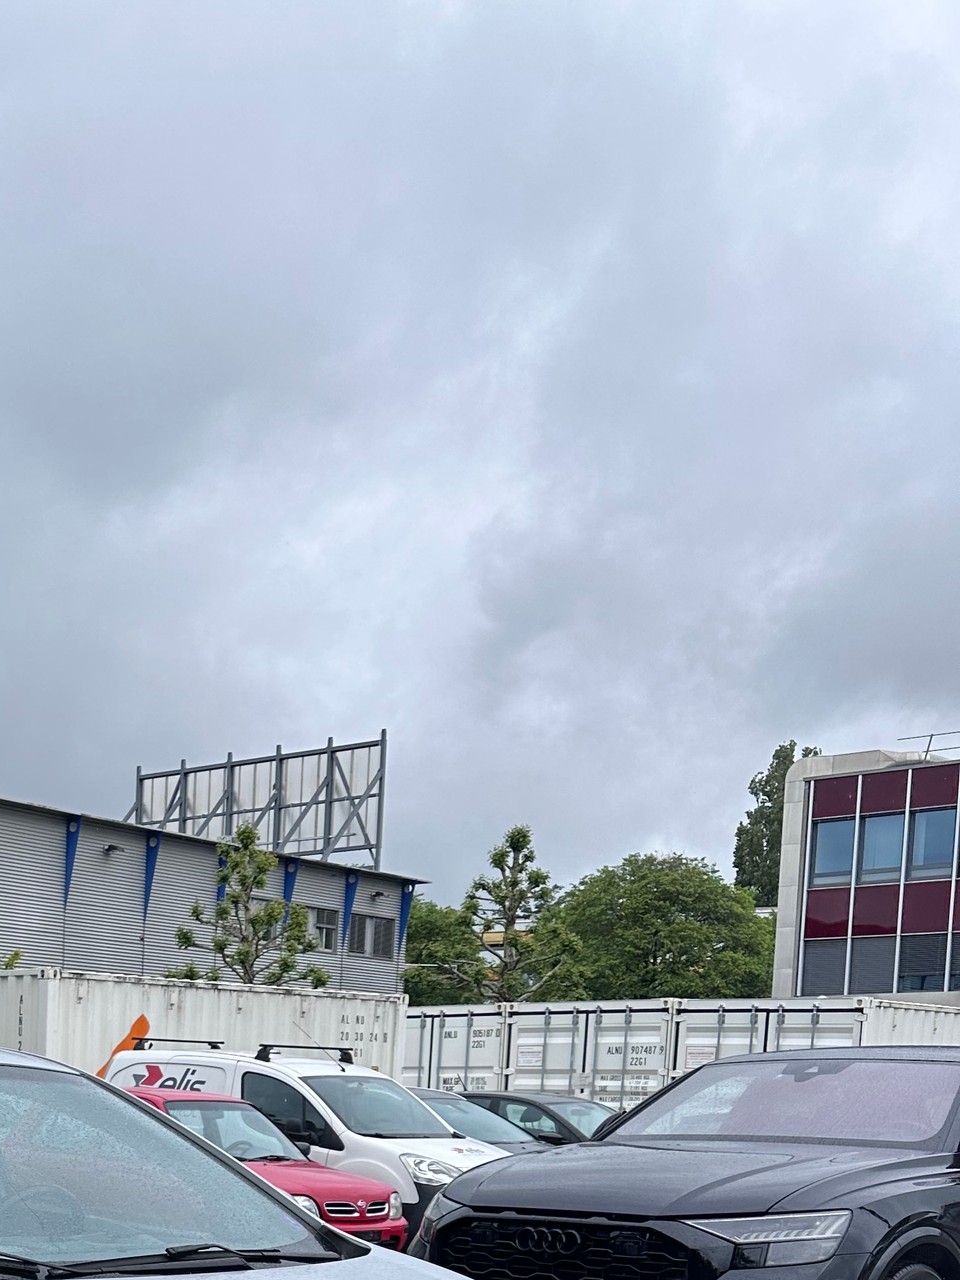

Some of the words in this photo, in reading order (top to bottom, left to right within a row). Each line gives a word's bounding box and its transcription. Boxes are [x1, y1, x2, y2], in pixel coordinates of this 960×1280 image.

[606, 1045, 623, 1055] ALNU
[630, 1045, 657, 1055] 907487
[629, 1056, 647, 1066] 22G1
